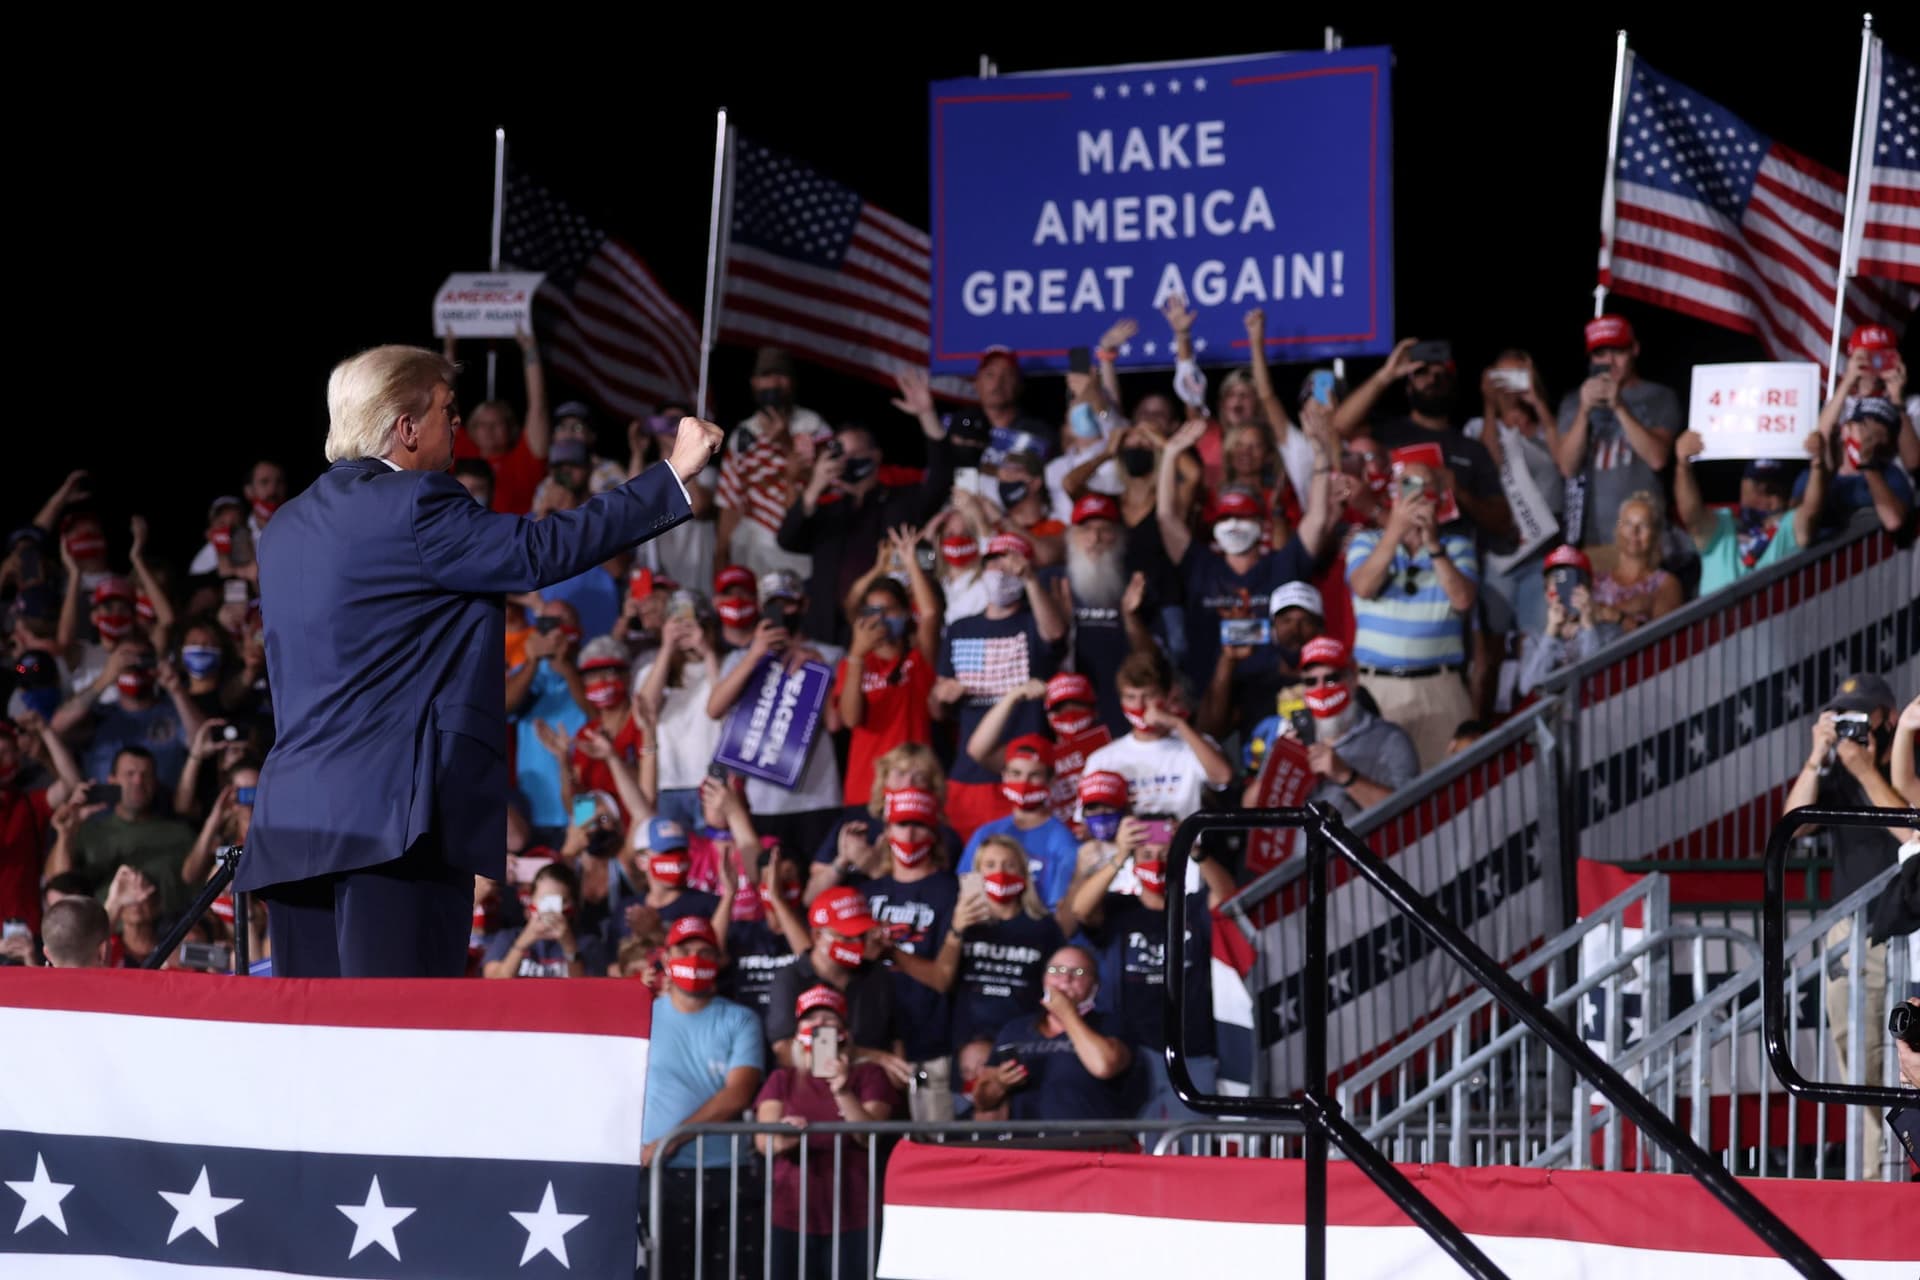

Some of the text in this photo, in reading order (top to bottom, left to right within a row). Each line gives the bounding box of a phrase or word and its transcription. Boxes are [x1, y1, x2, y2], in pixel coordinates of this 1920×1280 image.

[1078, 121, 1226, 175] MAKE
[1033, 186, 1276, 246] AMERICA
[962, 250, 1344, 317] GREAT AGAIN!
[443, 289, 525, 304] AMERICA
[441, 309, 480, 320] GREAT
[1709, 387, 1800, 407] 4 RE
[1708, 414, 1796, 433] RS!
[1306, 690, 1347, 711] TRUMP
[738, 660, 784, 763] PROTESTER
[758, 668, 807, 769] PEACEFUL
[1001, 786, 1048, 804] TRUMP
[963, 941, 1042, 964] TRUMP
[673, 963, 717, 980] TRUMP
